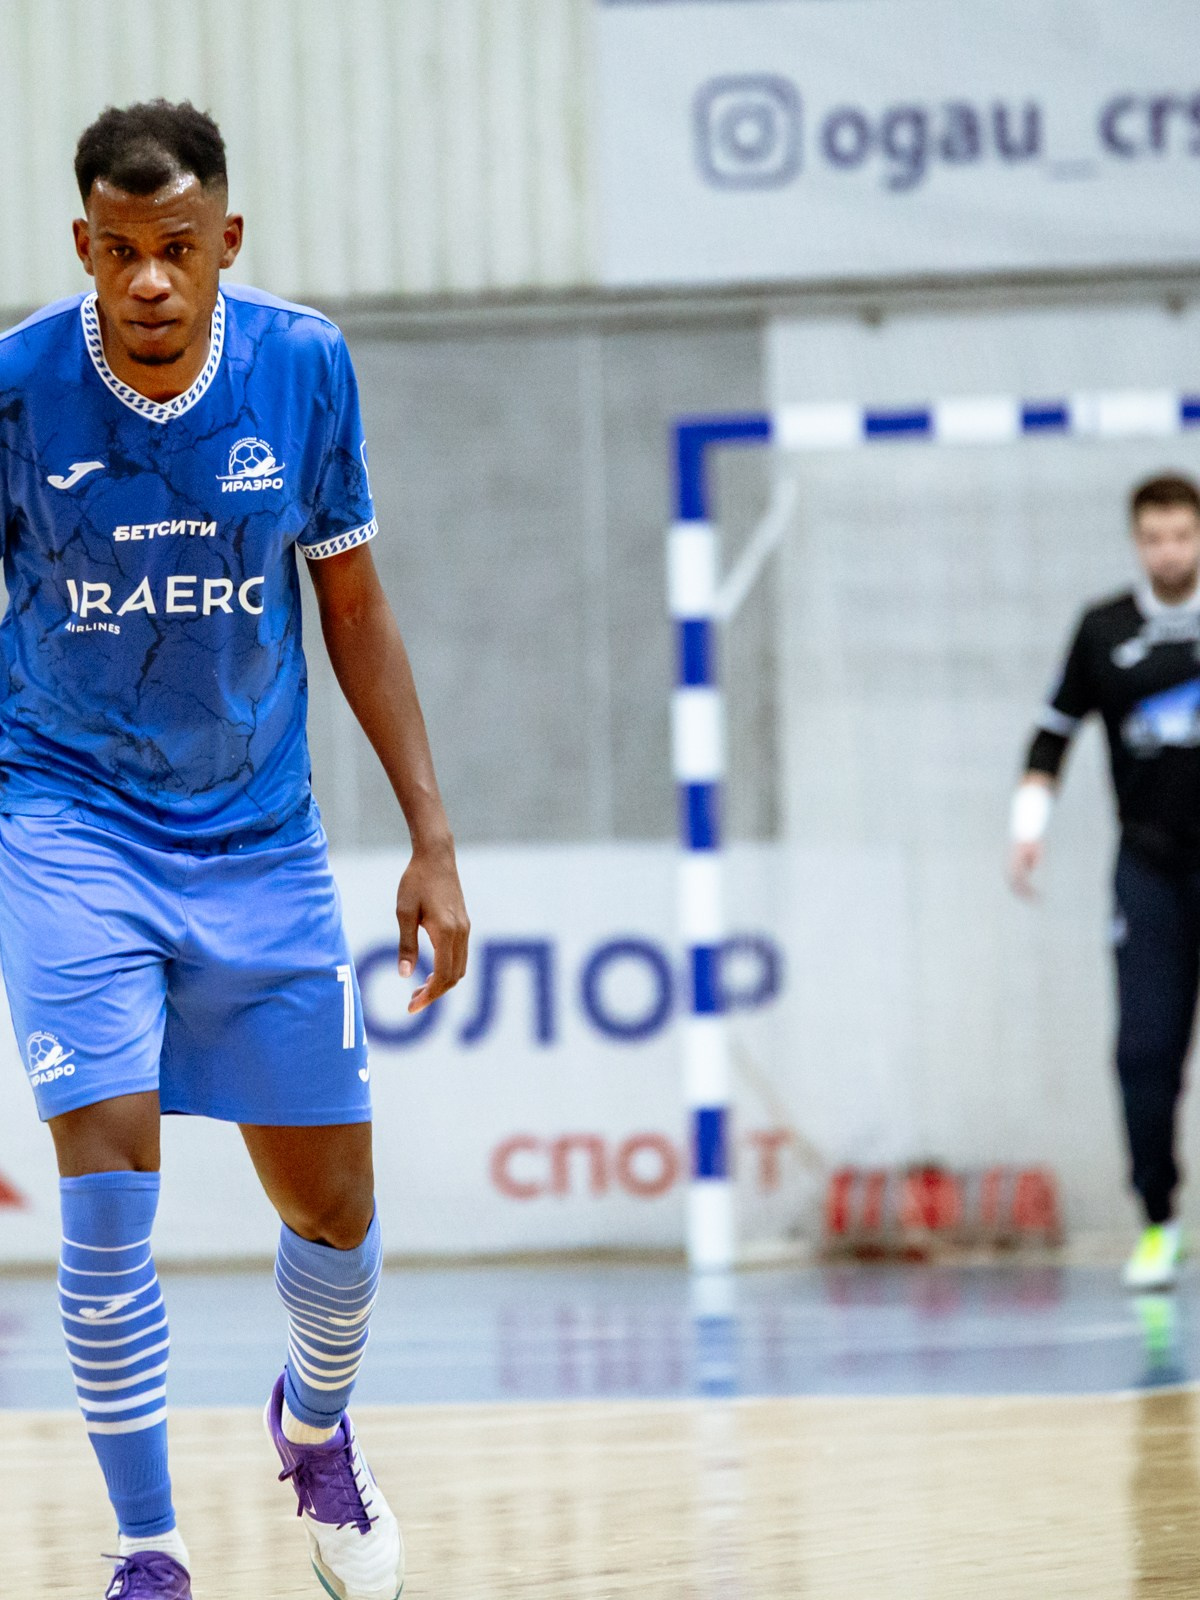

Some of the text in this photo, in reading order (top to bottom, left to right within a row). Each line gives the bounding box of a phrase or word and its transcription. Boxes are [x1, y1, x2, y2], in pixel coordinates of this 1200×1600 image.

[221, 477, 284, 493] ИРАЭРО
[112, 520, 217, 542] БЕТСИТИ
[64, 621, 121, 635] AIRLINES
[490, 1131, 796, 1199] спот
